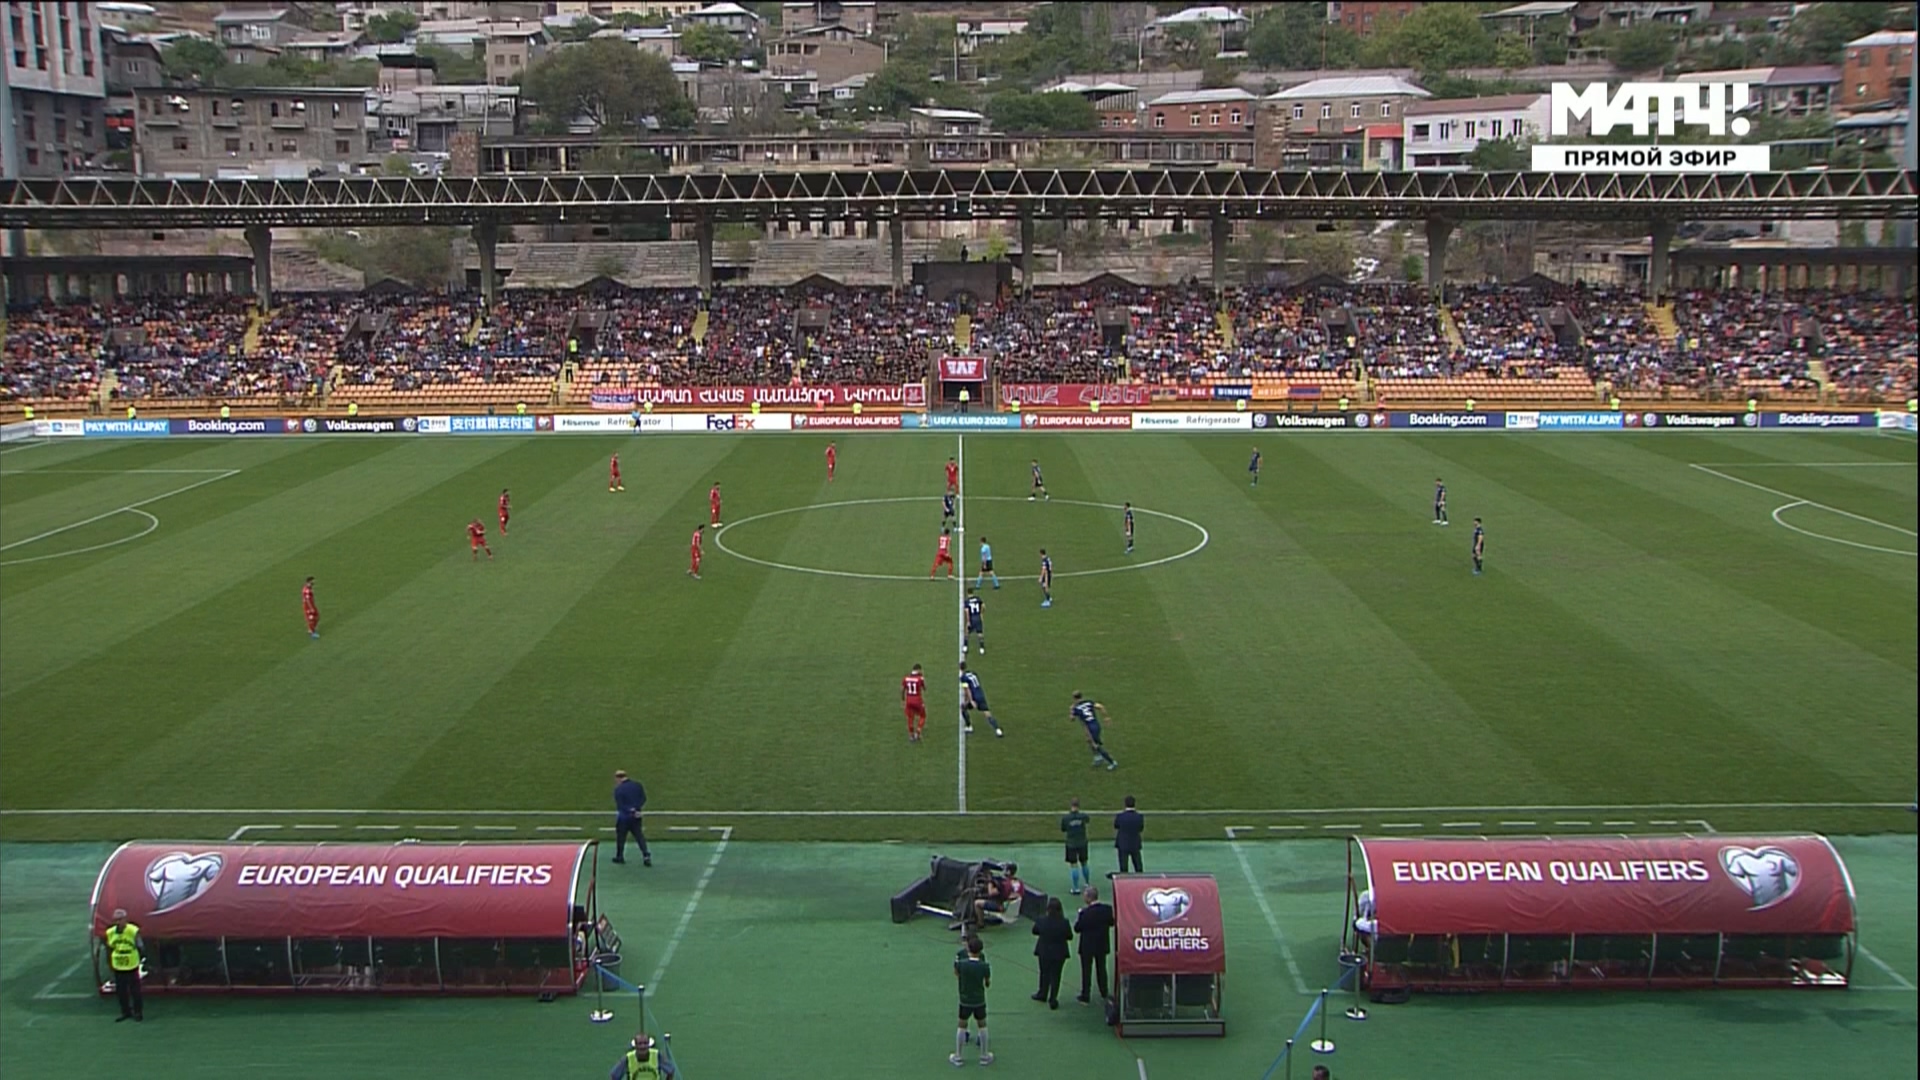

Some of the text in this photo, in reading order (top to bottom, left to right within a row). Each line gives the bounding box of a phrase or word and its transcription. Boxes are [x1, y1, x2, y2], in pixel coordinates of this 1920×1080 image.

[706, 414, 755, 429] FedEx
[809, 417, 899, 426] EUROPEAN QUALIFIERS
[934, 417, 1008, 425] UEFA EURO 2020
[1039, 416, 1130, 426] EUROPEAN QUALIFIERS
[1186, 416, 1240, 426] Refrigerator
[1276, 415, 1345, 428] Volkswagen
[1409, 413, 1487, 427] Booking.com
[1540, 414, 1560, 425] PAY
[1560, 414, 1587, 425] WITH
[1587, 414, 1622, 425] ALIPAY
[1666, 415, 1734, 427] Volkswagen
[1779, 413, 1860, 427] Booking.com
[85, 421, 106, 432] PAY
[106, 421, 133, 432] WITH
[133, 421, 167, 432] ALIPAY
[188, 420, 265, 433] Booking.com
[326, 420, 394, 432] Volkswagen
[907, 682, 918, 694] 11
[237, 864, 553, 889] EUROPEAN QUALIFIERS
[1392, 861, 1709, 885] EUROPEAN QUALIFIERS
[1141, 927, 1201, 937] EUROPEAN
[1134, 938, 1209, 952] QUALIFIERS
